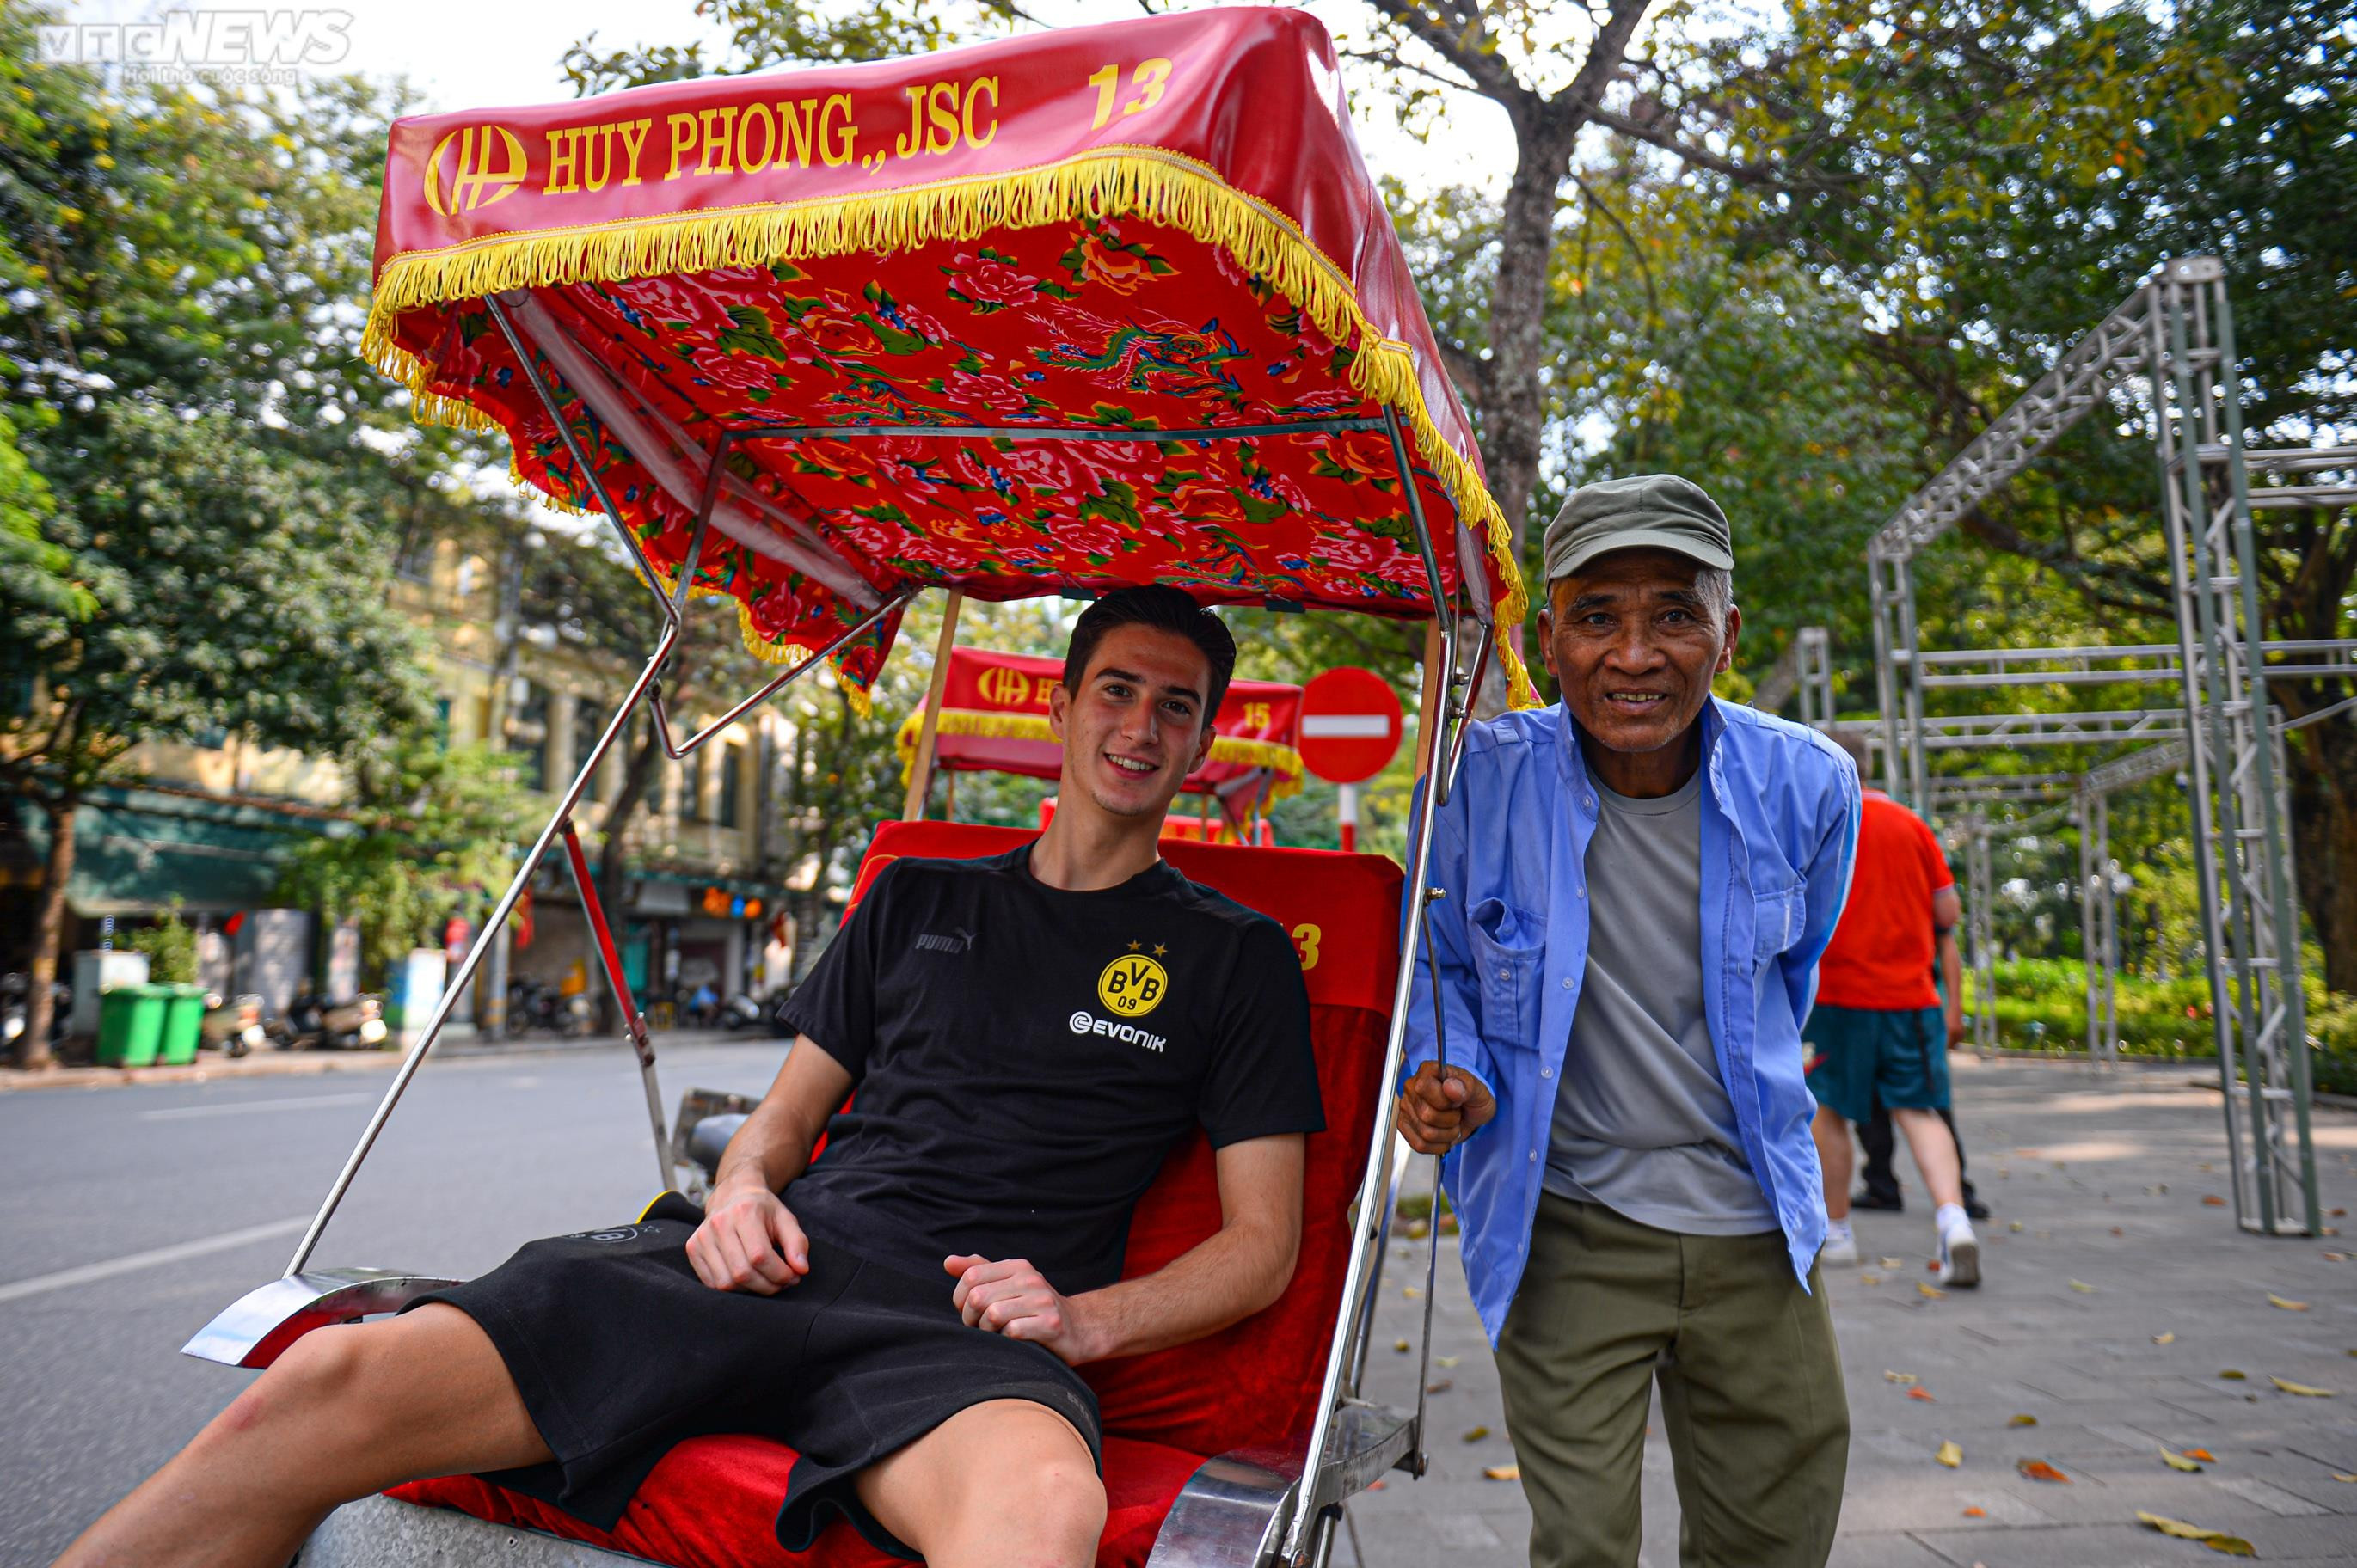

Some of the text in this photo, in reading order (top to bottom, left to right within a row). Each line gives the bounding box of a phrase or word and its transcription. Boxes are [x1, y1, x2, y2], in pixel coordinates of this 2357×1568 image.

[1089, 57, 1173, 131] 13
[543, 118, 652, 195] HUY
[895, 75, 999, 159] JSC
[1243, 702, 1271, 729] 15
[1292, 922, 1322, 971] 3
[1107, 961, 1160, 1001] BVB
[1117, 995, 1138, 1010] 09
[1092, 1019, 1167, 1053] EVONIK
